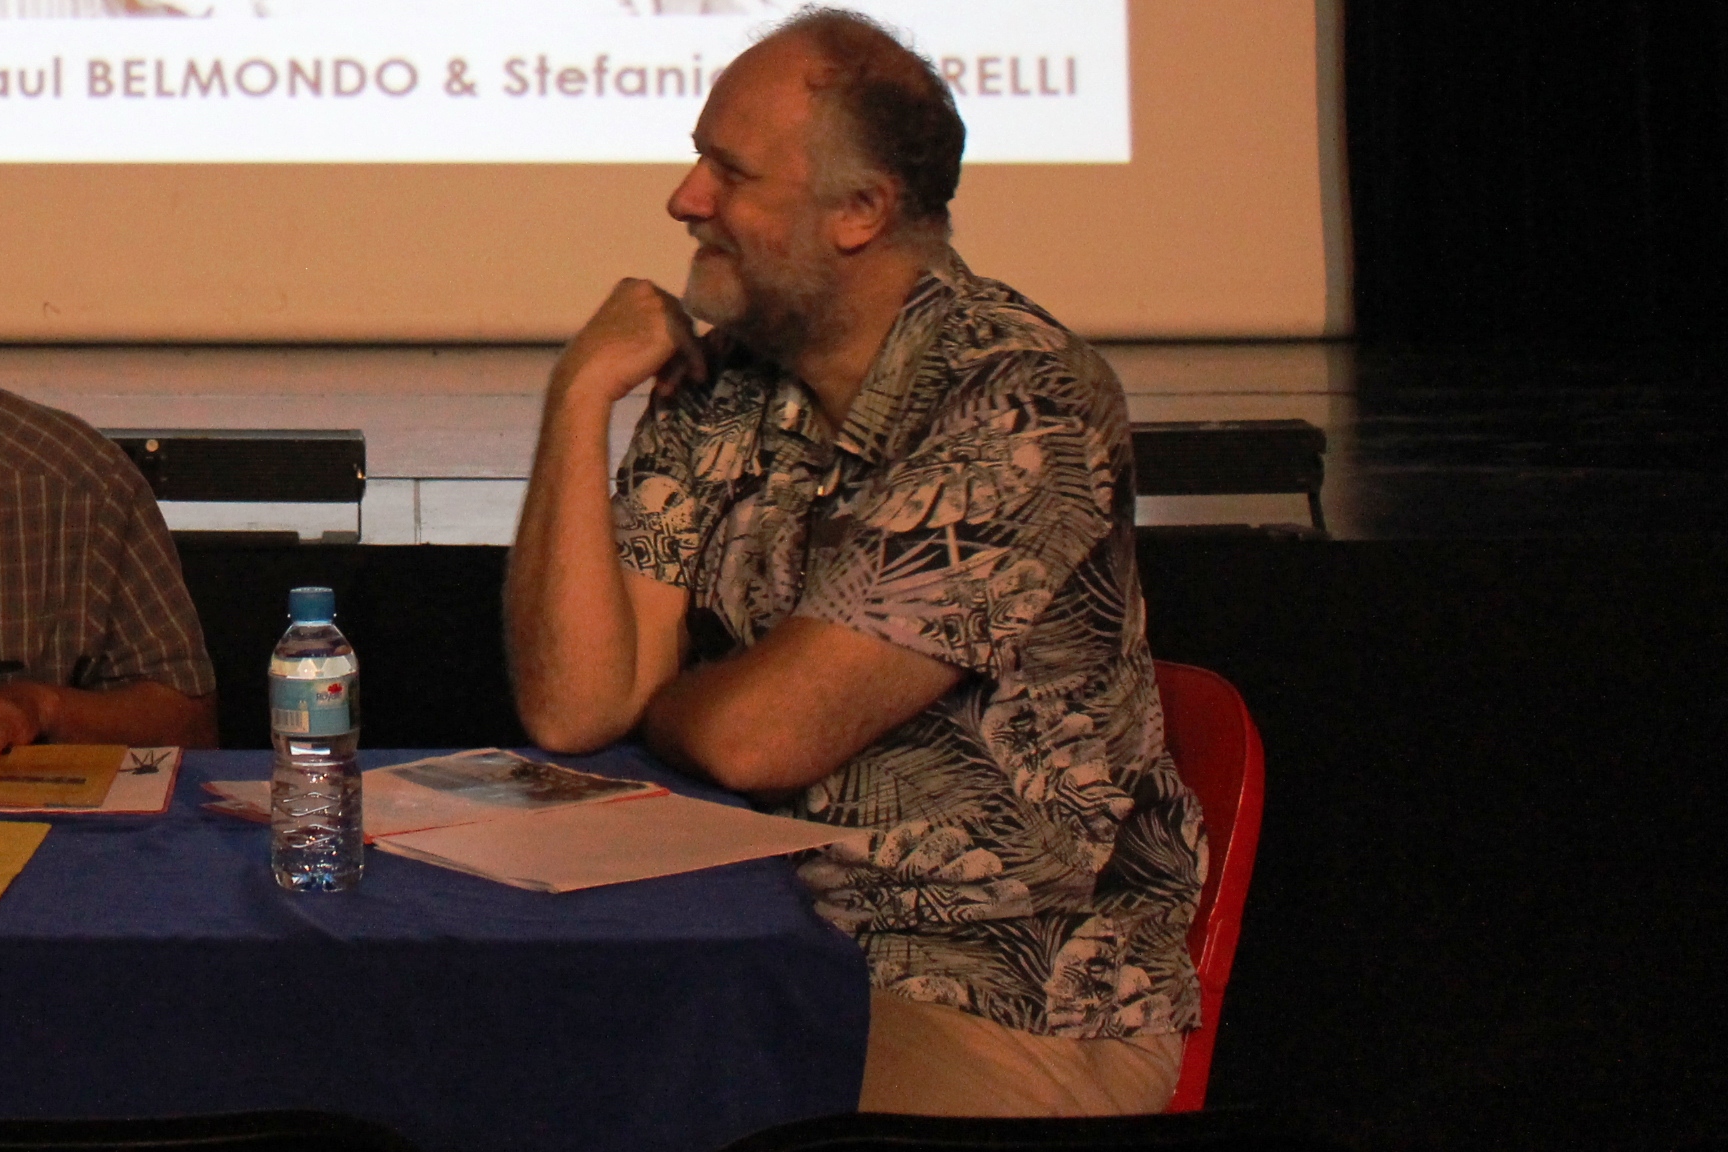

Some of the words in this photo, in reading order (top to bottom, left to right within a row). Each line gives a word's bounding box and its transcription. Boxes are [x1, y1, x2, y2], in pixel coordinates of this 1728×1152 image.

[86, 58, 419, 98] BELMONDO
[443, 57, 478, 98] &
[503, 53, 725, 98] Stefani
[940, 55, 1077, 97] RELLI
